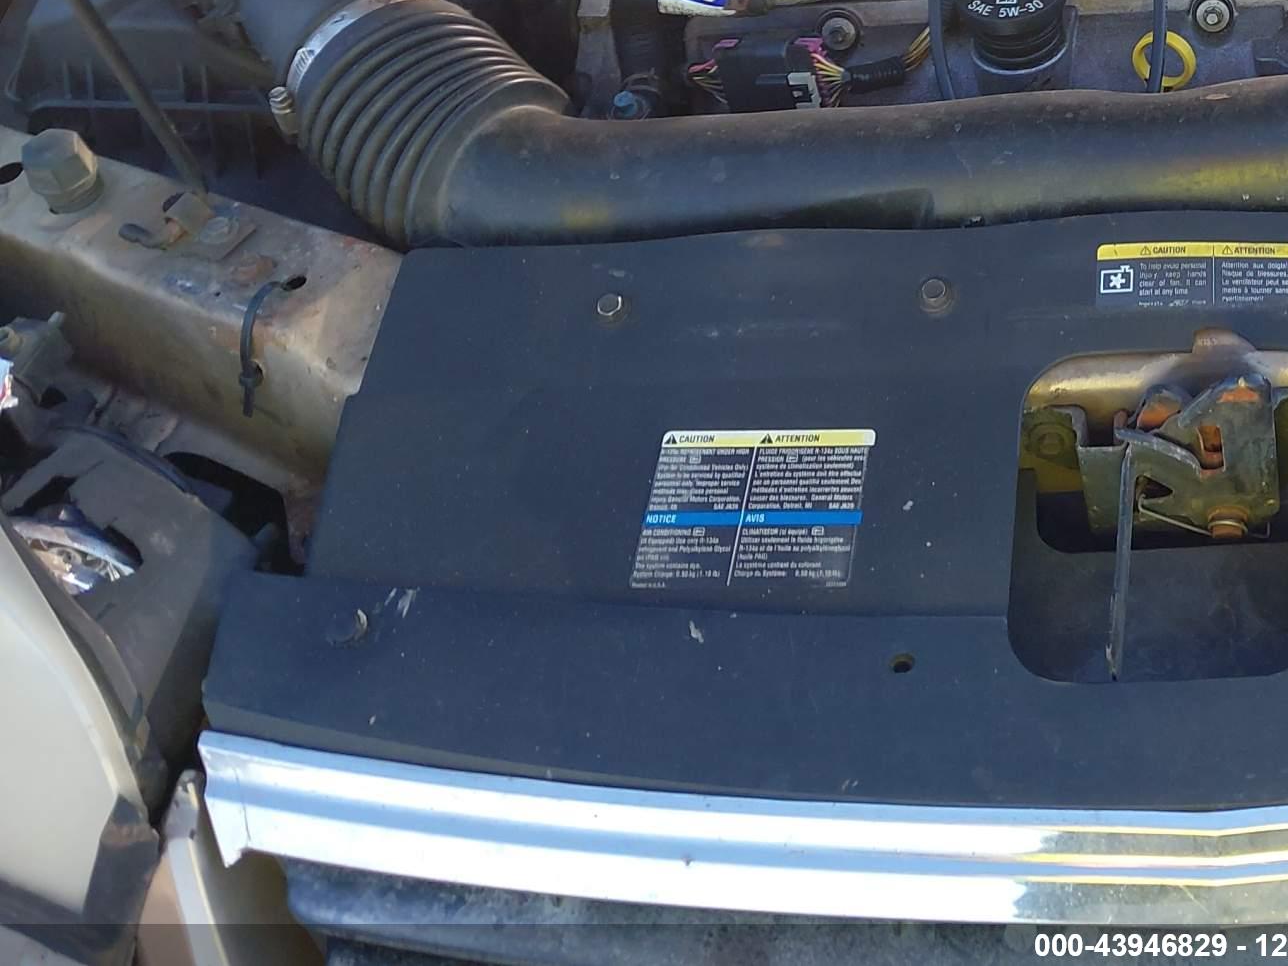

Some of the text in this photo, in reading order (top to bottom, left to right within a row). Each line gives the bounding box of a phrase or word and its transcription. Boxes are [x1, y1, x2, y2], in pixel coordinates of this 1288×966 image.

[968, 0, 1044, 17] SAE 5W-30
[679, 434, 715, 443] CAUTION
[775, 434, 819, 443] ATTENTION
[646, 514, 677, 523] NOTICE
[745, 514, 764, 522] AVIS
